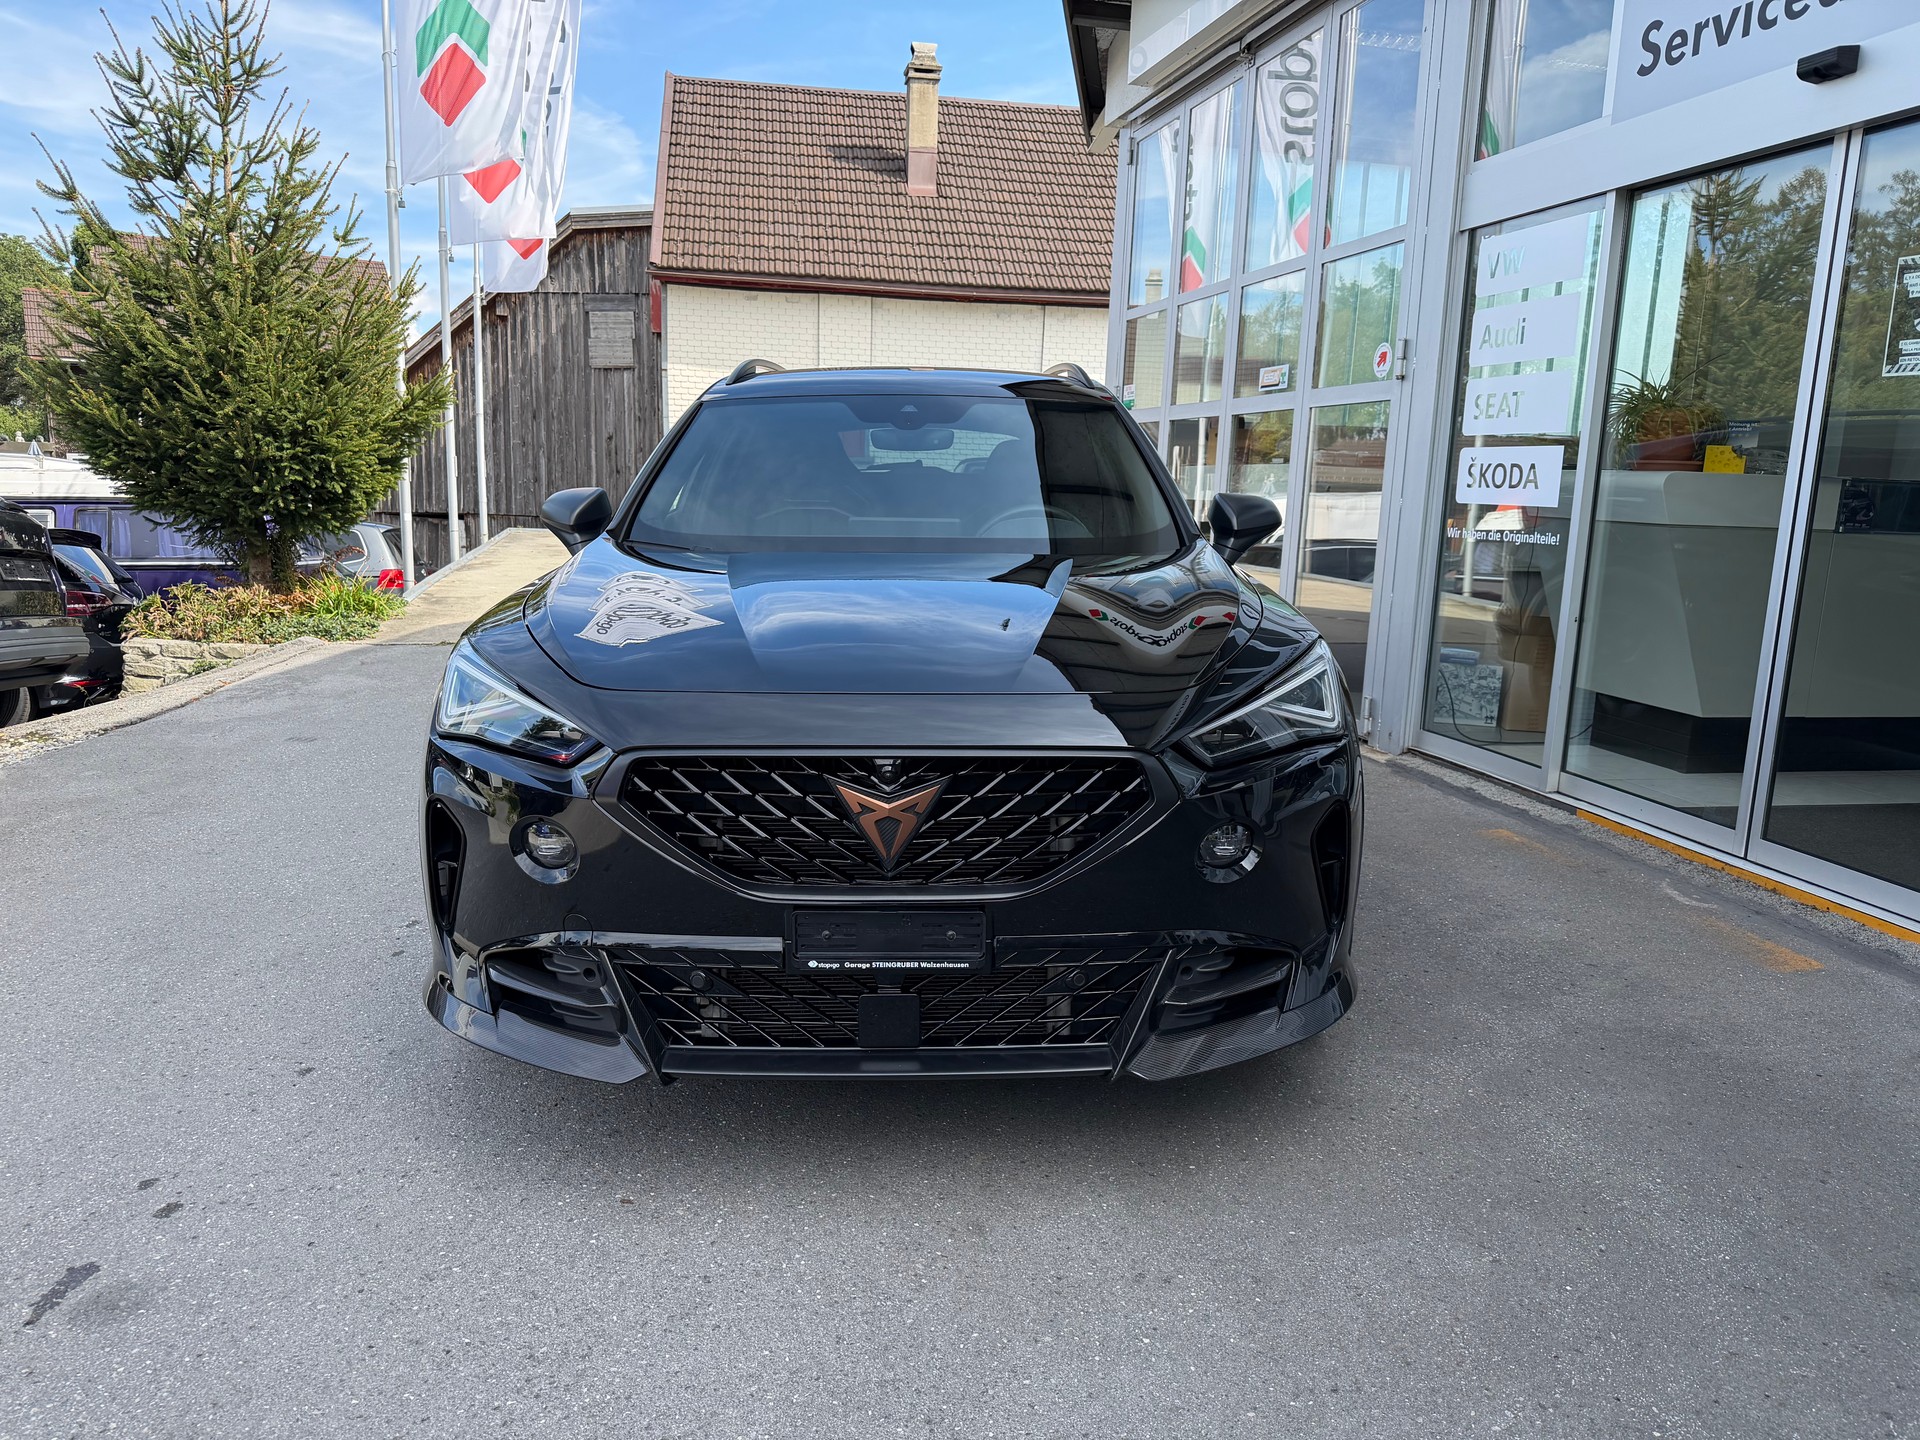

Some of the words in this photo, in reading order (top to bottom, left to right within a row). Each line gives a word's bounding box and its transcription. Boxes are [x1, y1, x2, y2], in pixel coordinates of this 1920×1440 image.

[1488, 246, 1526, 279] VW
[1479, 318, 1527, 350] Audi
[1473, 391, 1526, 420] SEAT
[1466, 456, 1539, 489] ŠKODA
[1447, 528, 1461, 538] Wir
[1462, 528, 1486, 540] haben
[1488, 531, 1501, 541] die
[1503, 531, 1560, 545] Originalteile!
